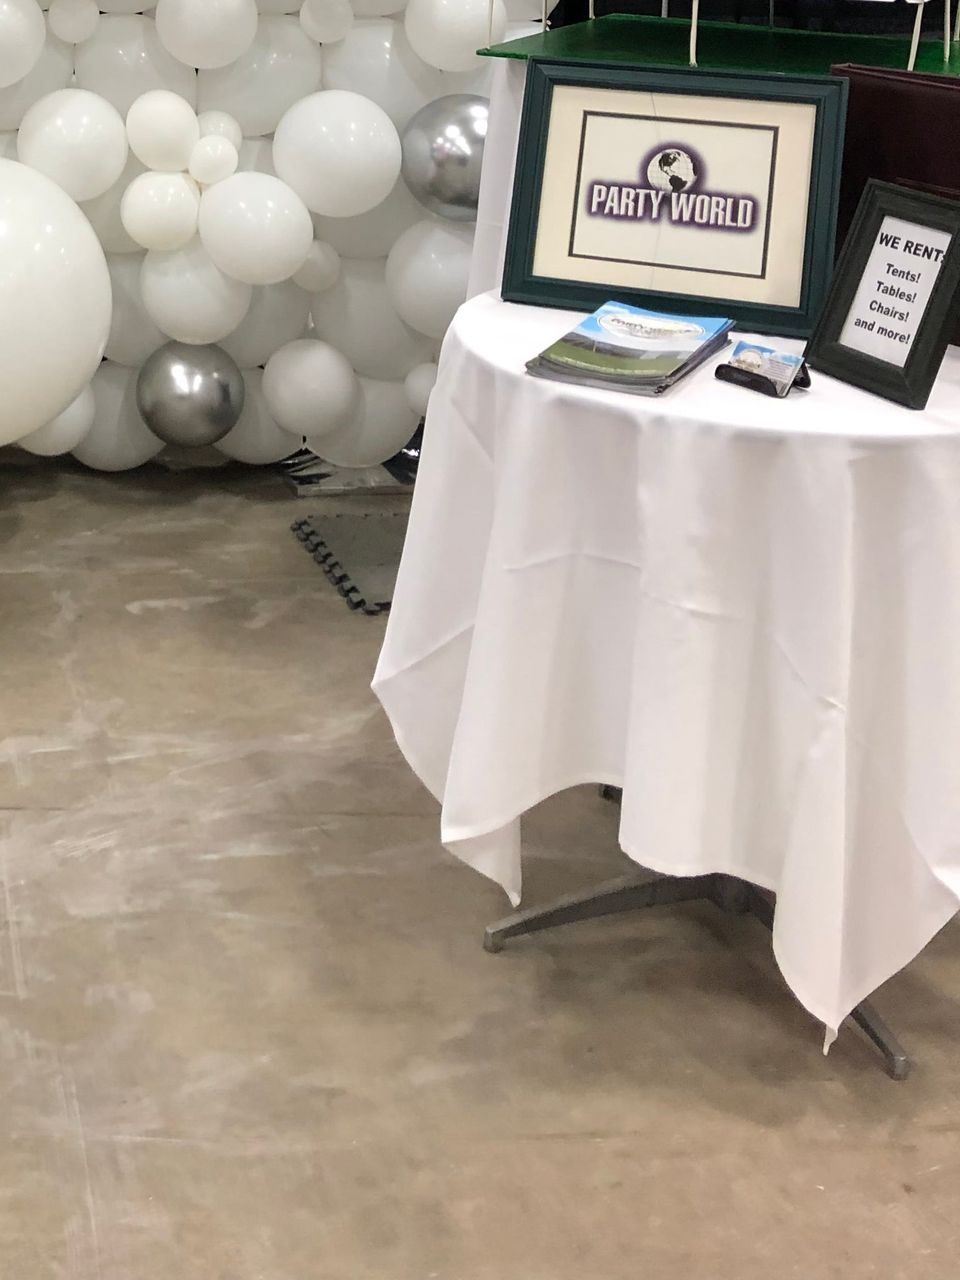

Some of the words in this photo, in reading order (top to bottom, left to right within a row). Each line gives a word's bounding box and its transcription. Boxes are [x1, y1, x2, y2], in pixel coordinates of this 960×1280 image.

[591, 185, 664, 219] PARTY
[671, 191, 754, 228] WORLD
[879, 232, 902, 251] WE
[885, 263, 922, 284] Tents!
[876, 280, 917, 303] Tables!
[869, 300, 910, 322] Chairs!
[854, 318, 876, 332] and
[877, 325, 911, 344] more!
